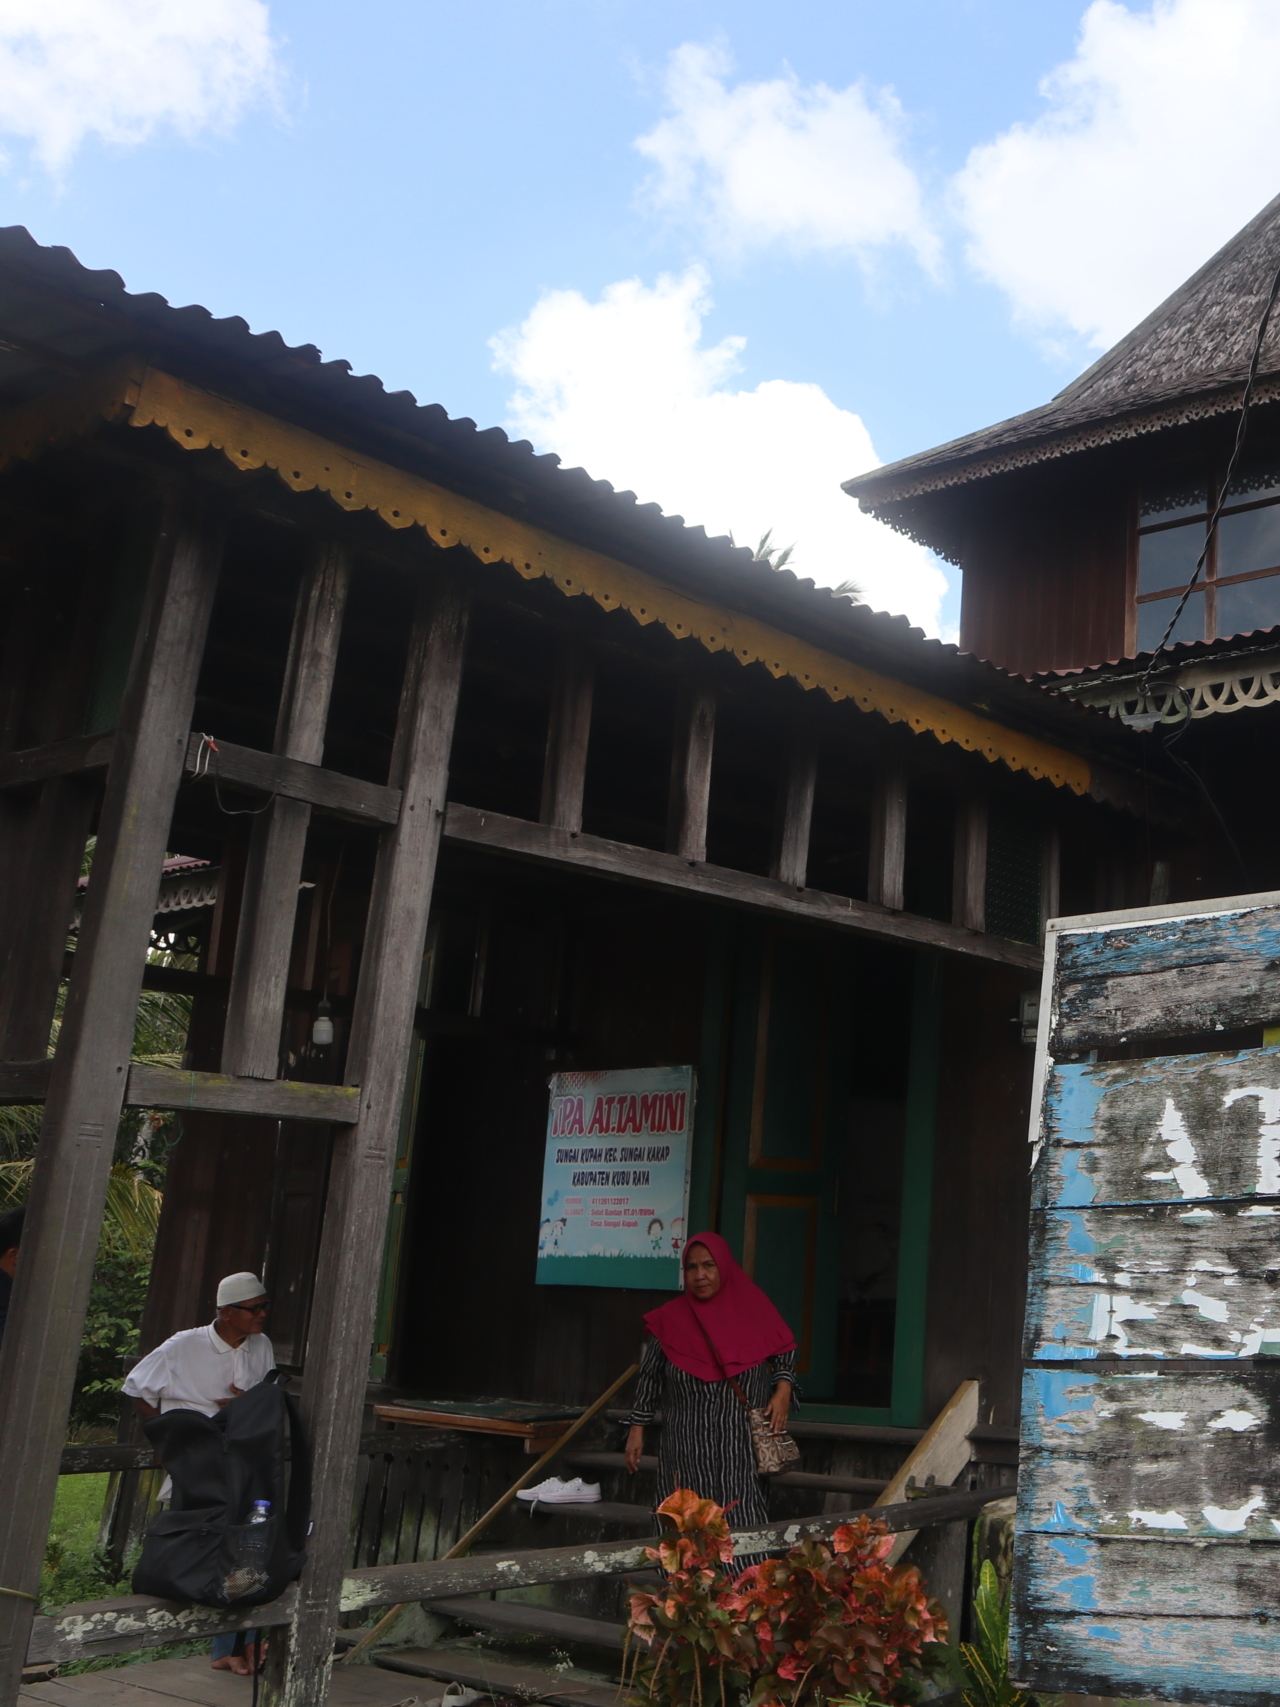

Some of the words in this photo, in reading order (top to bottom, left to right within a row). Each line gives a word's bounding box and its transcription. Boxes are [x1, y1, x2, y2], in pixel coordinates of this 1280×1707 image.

[551, 1096, 585, 1136] TPA
[587, 1092, 687, 1136] AT.TAMINI
[556, 1148, 580, 1164] SUNGAI
[580, 1147, 603, 1164] KUPAH
[604, 1147, 618, 1163] KEC.
[619, 1147, 646, 1163] SUNGAI
[646, 1146, 670, 1163] KAKAP
[571, 1171, 610, 1187] KABUPATEN
[611, 1171, 632, 1186] KUBU
[632, 1170, 650, 1186] RAYA
[603, 1219, 622, 1229] Sungai
[622, 1219, 638, 1229] Kupah
